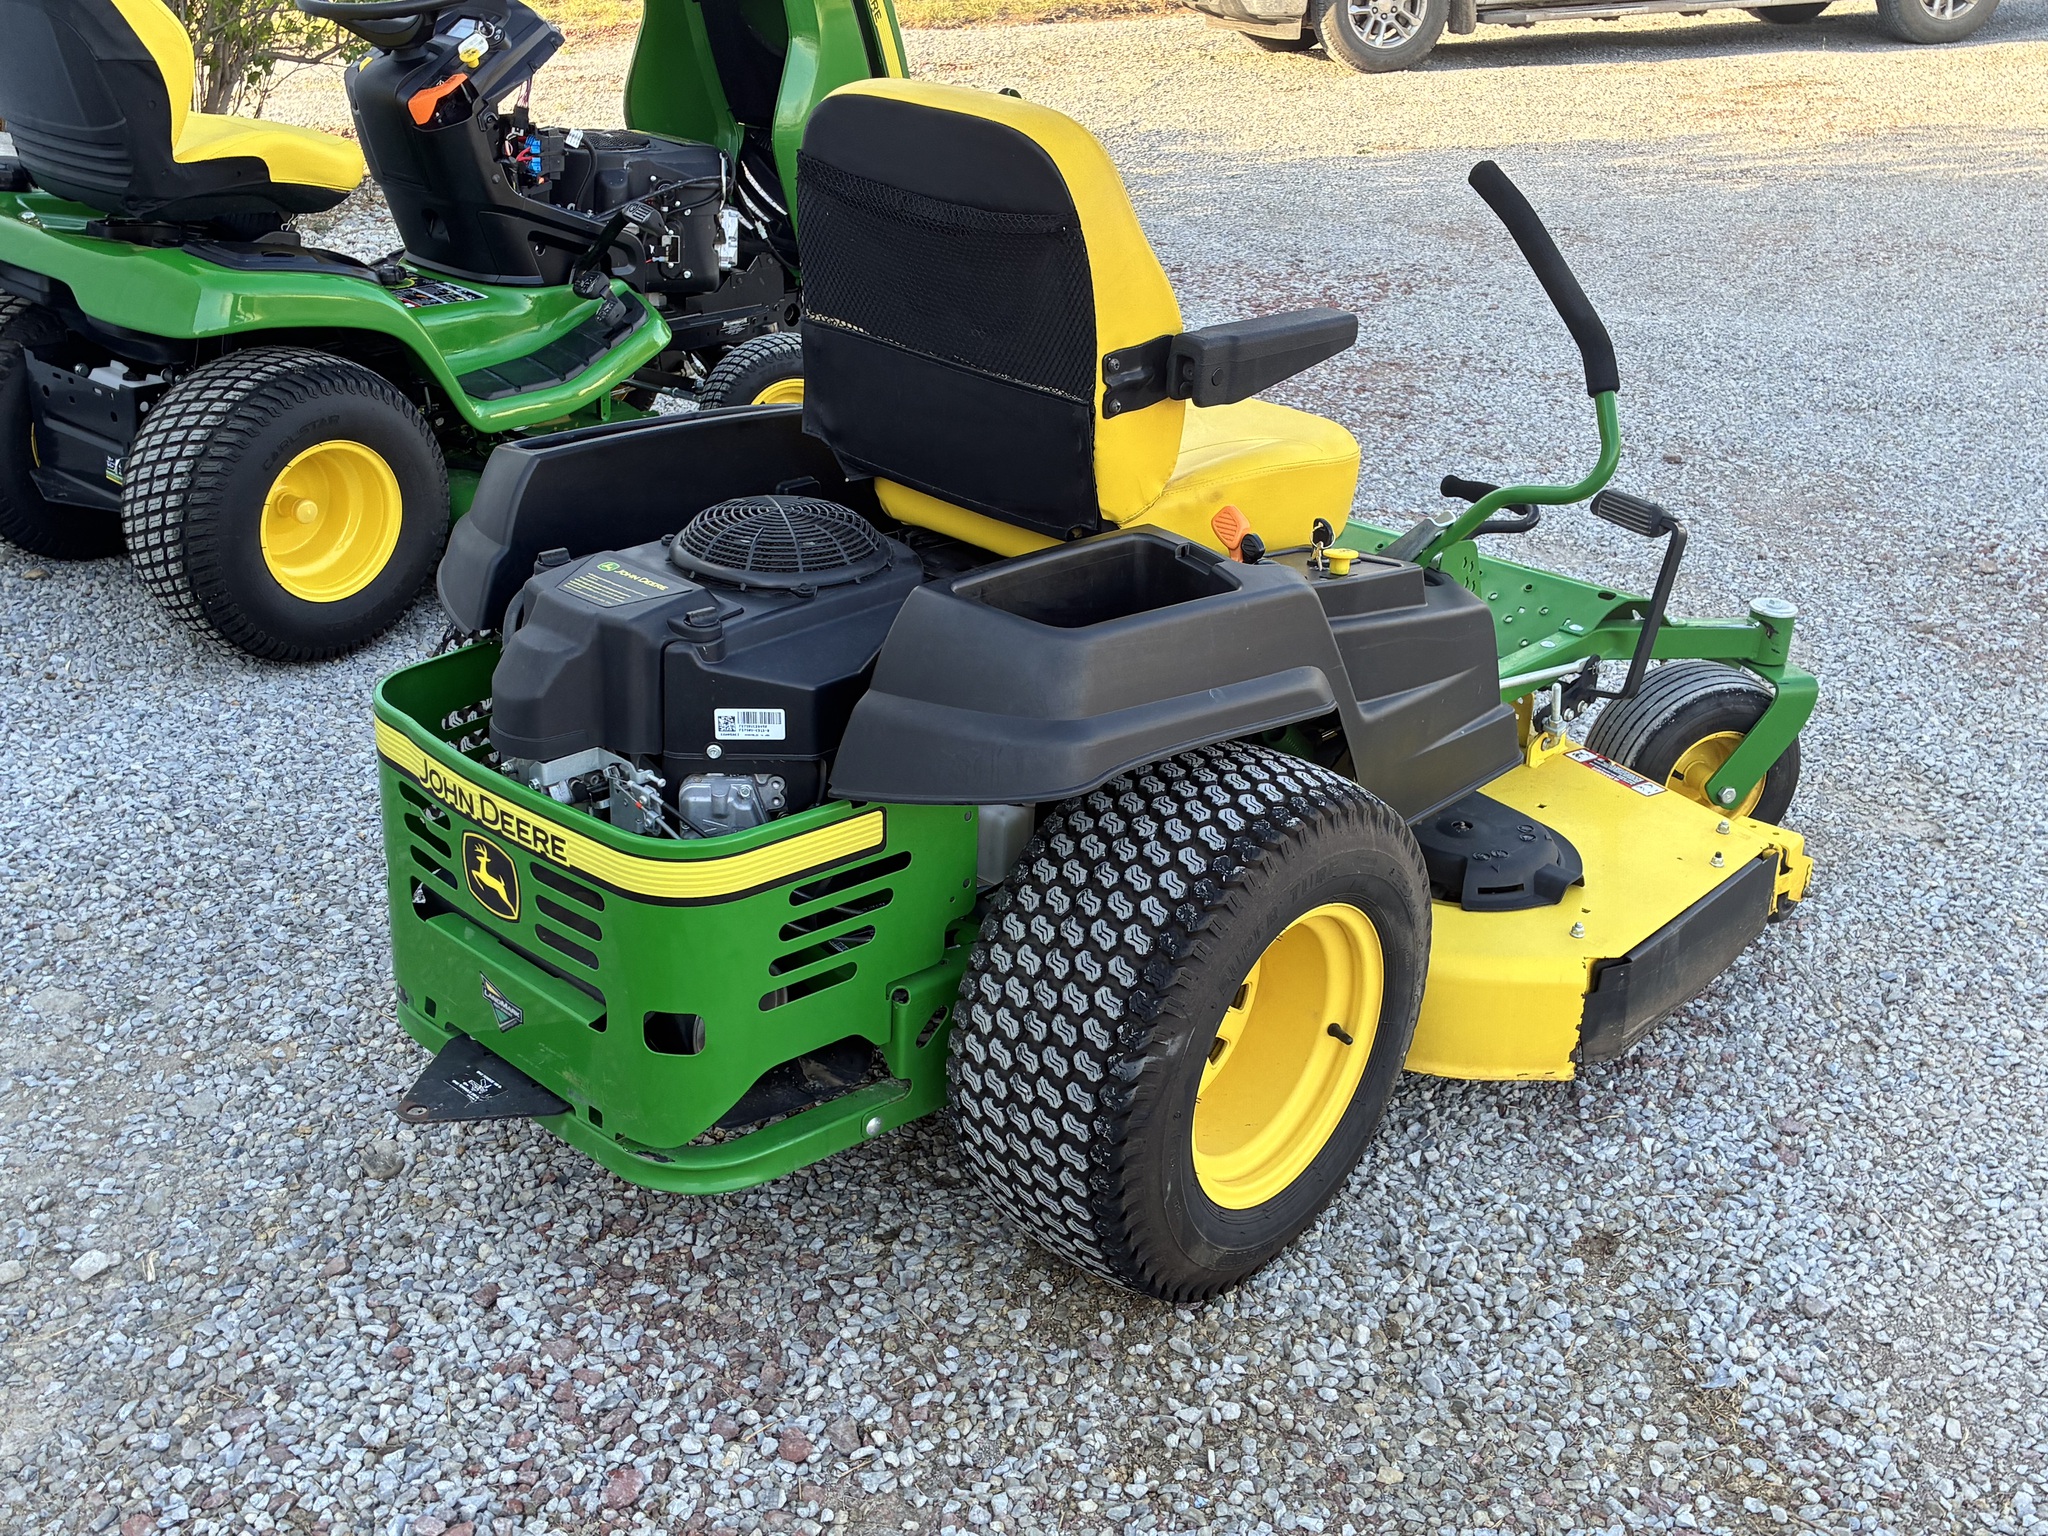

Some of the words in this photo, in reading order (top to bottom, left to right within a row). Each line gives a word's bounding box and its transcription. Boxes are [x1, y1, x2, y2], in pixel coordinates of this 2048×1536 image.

[615, 568, 639, 582] JOHN
[638, 576, 669, 592] DEERE
[419, 758, 475, 816] JOHN
[479, 793, 568, 864] DEERE
